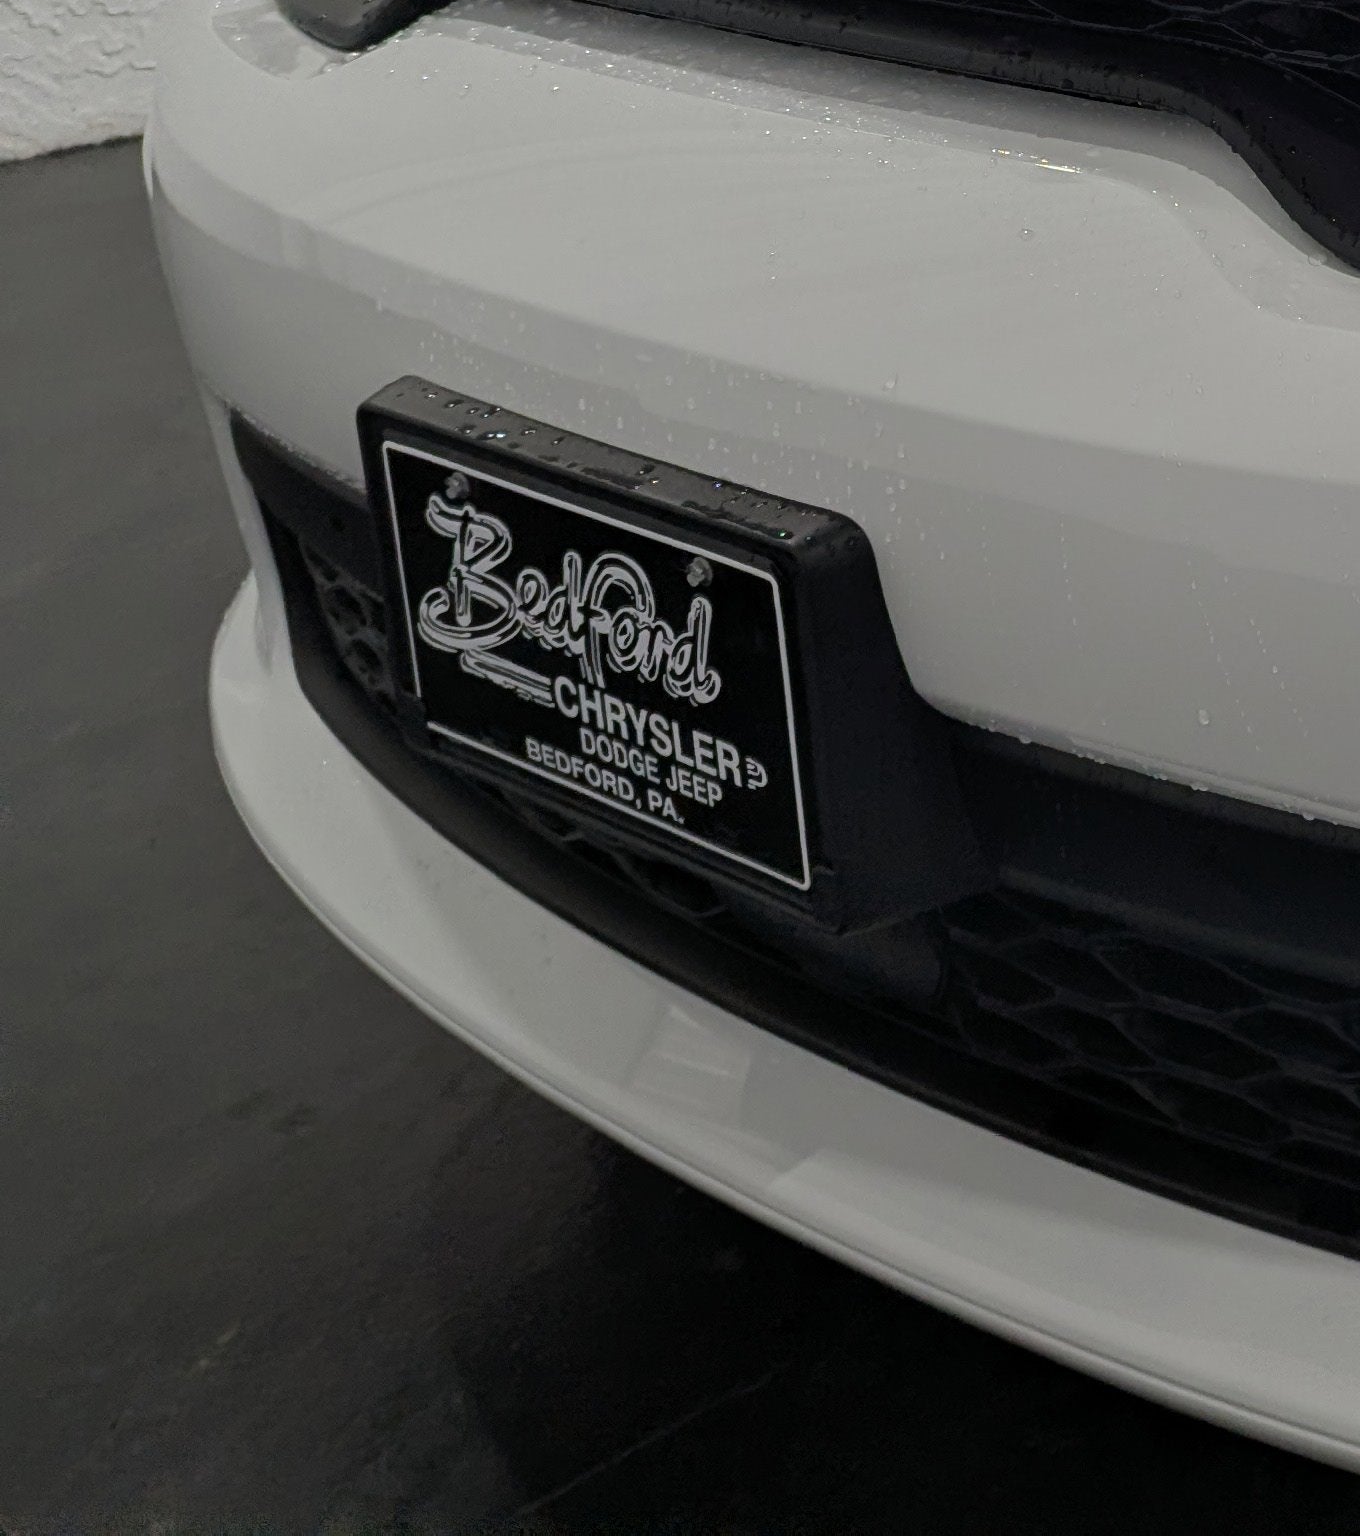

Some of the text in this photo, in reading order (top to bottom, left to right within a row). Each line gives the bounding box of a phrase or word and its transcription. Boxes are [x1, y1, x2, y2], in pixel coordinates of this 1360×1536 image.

[554, 675, 742, 787] CHRYSLER
[579, 727, 723, 808] DODGE JEEP
[525, 736, 642, 810] BEDFORD,
